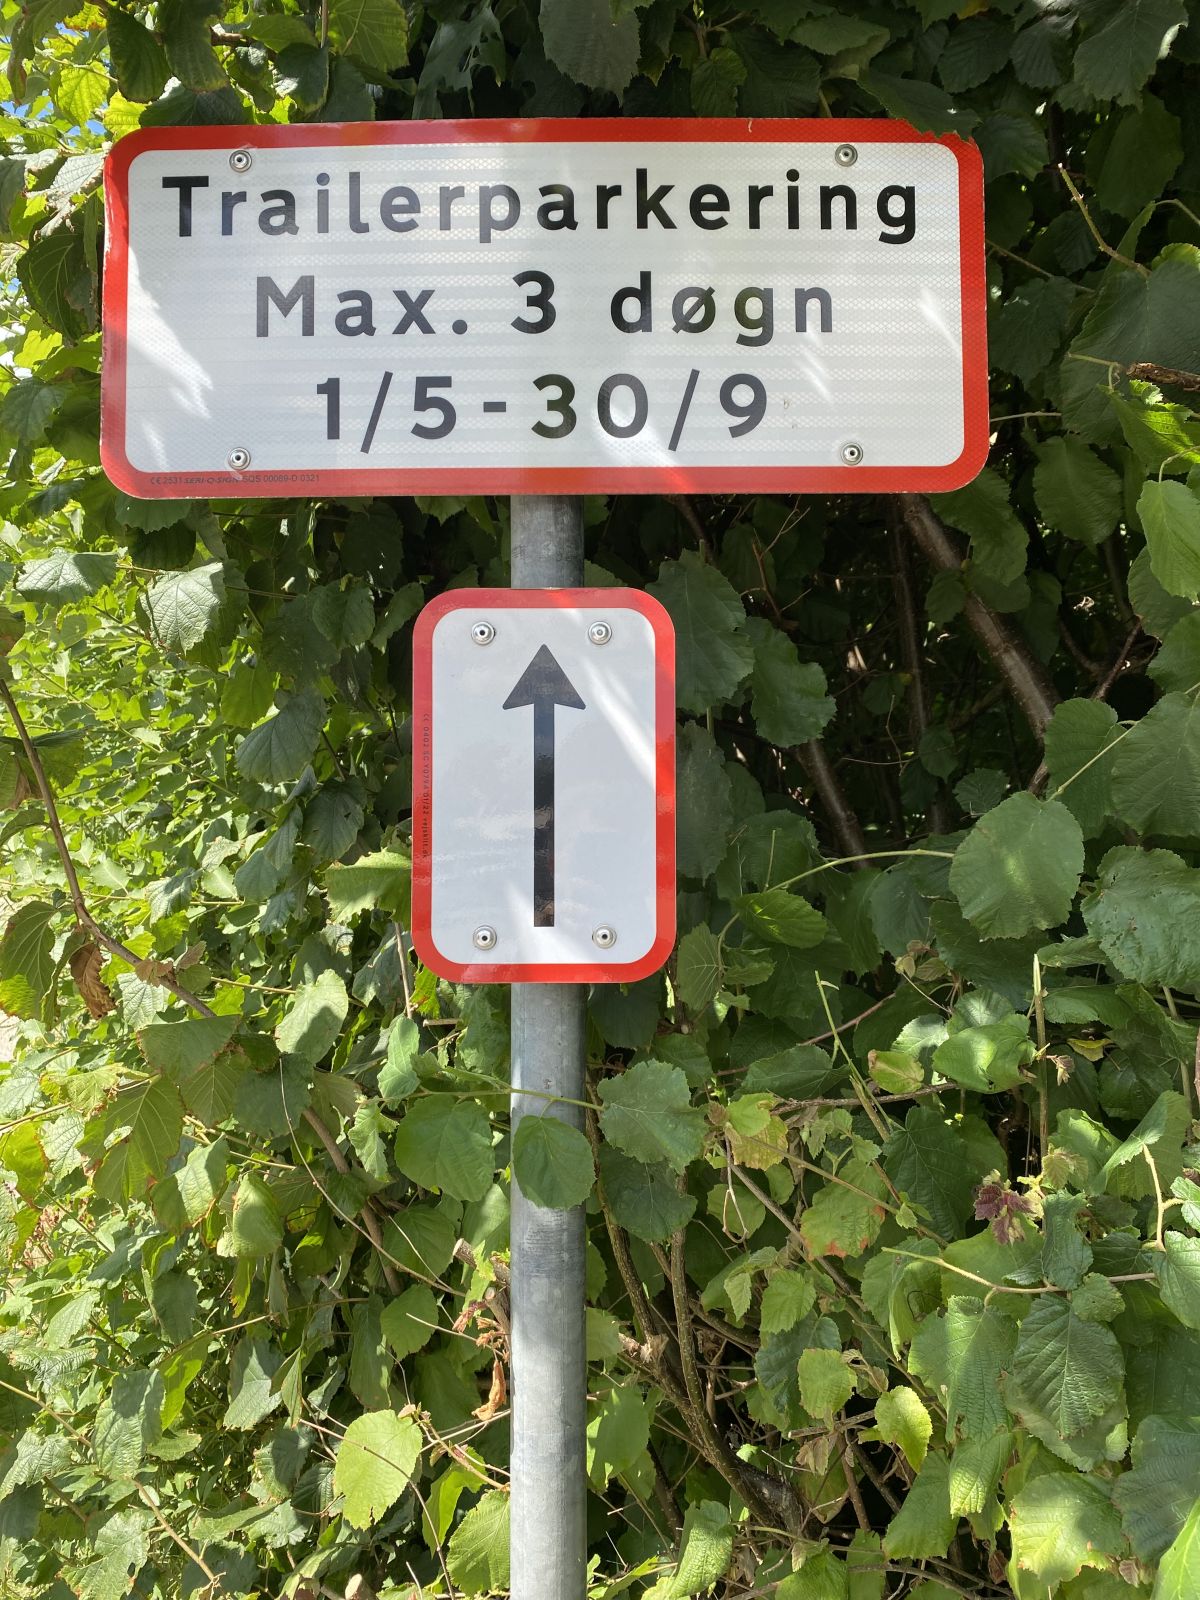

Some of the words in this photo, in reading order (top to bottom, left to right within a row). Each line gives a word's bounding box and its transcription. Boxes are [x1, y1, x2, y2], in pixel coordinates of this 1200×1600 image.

[161, 169, 916, 245] Trailerparkering
[256, 275, 468, 338] Max.
[510, 270, 557, 335] 3
[610, 270, 834, 348] døgn
